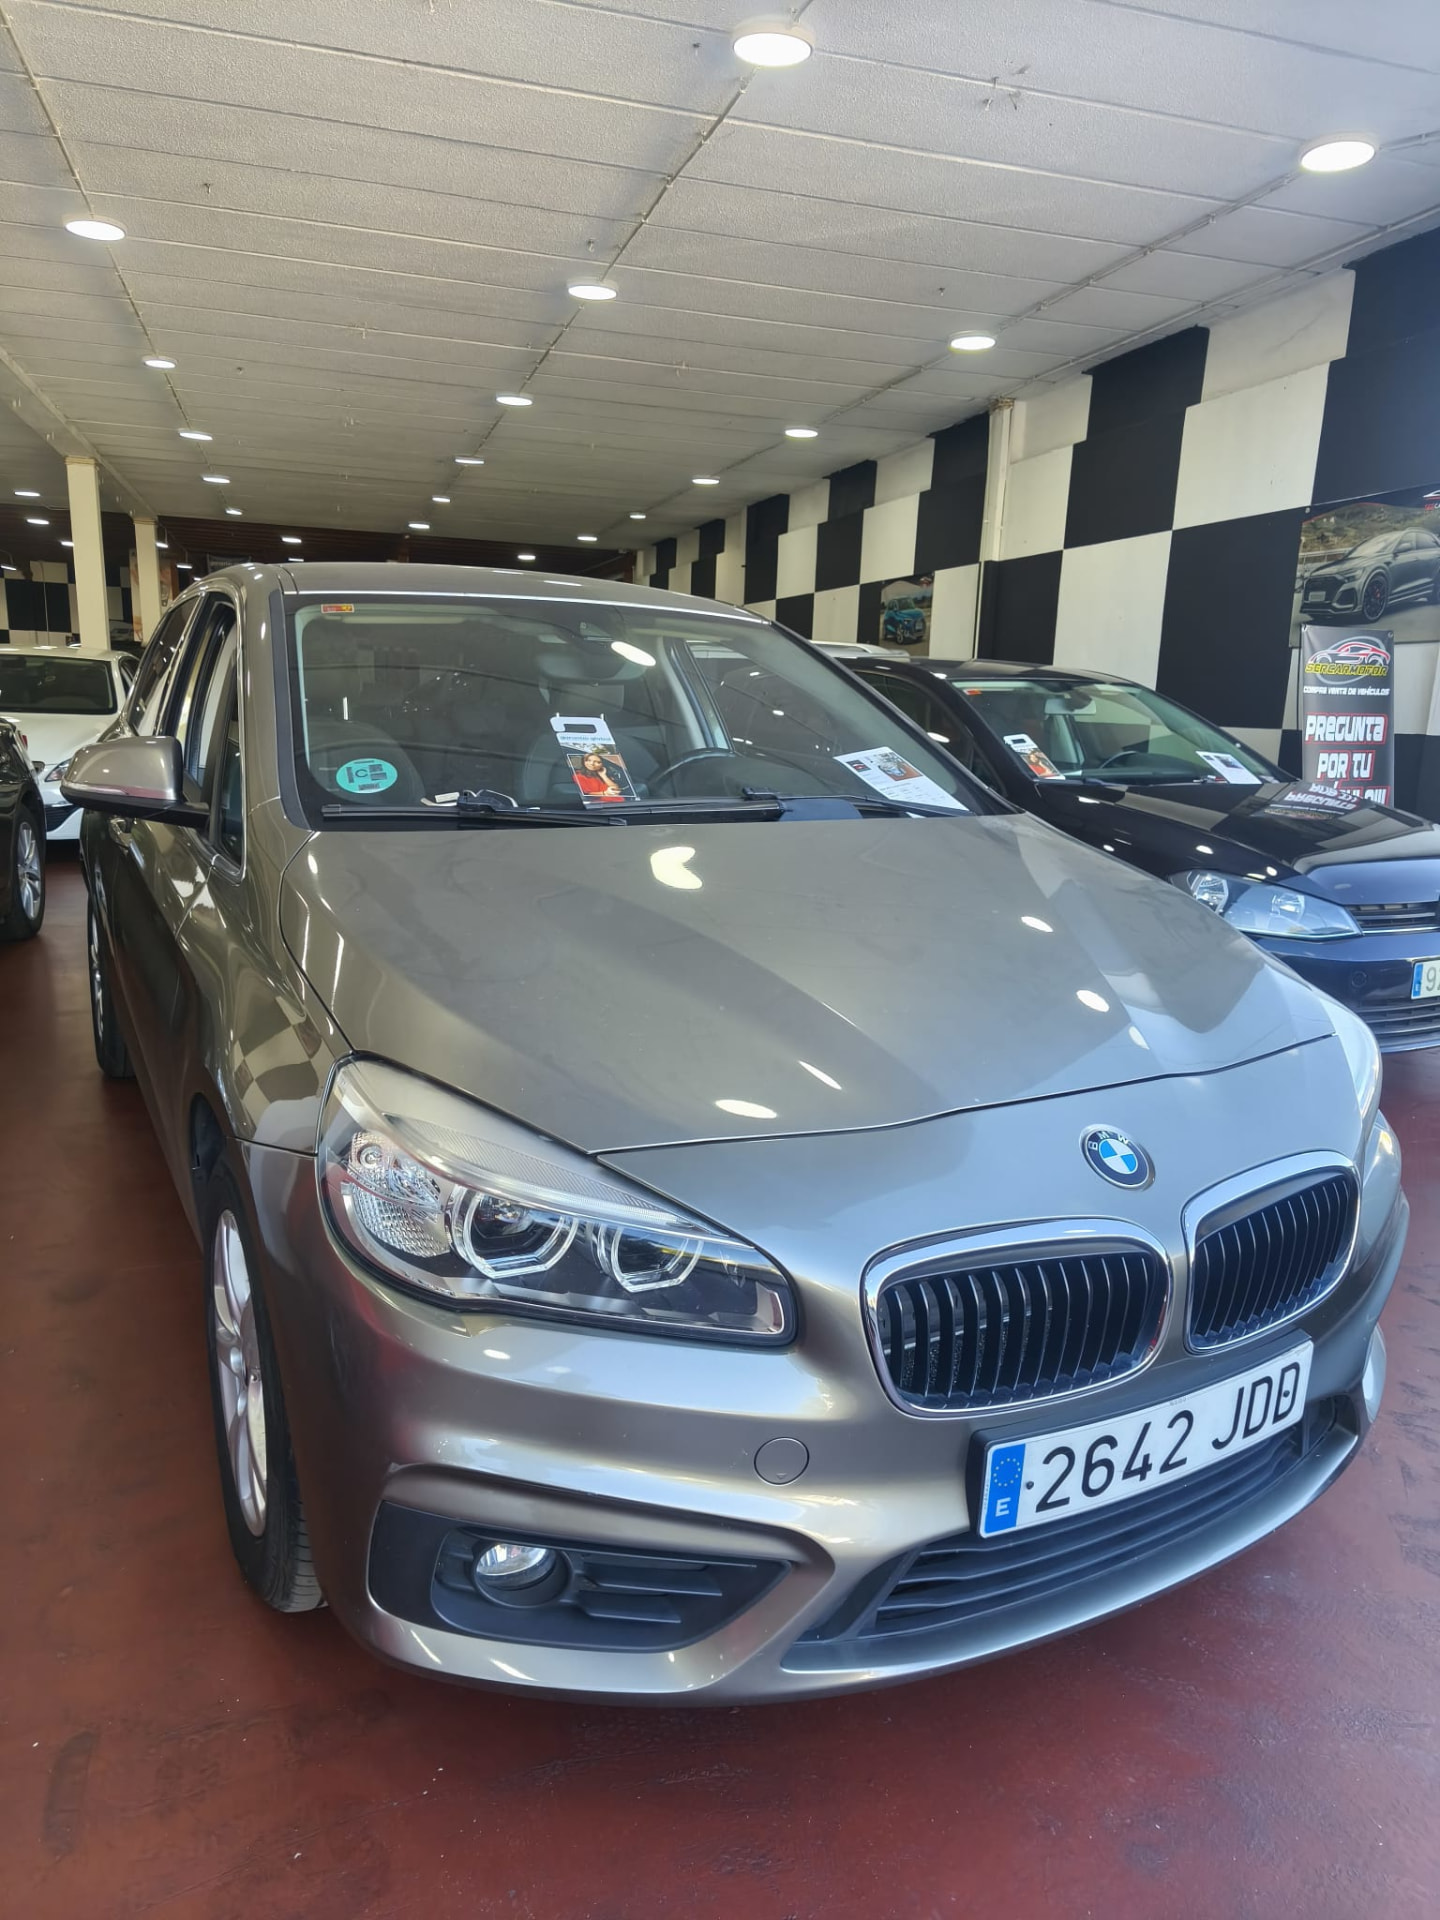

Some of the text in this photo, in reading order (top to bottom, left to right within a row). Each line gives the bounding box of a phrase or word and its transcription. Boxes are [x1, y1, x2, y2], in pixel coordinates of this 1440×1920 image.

[1305, 714, 1385, 742] PREGUNTA
[1316, 752, 1373, 779] POR TU
[1426, 966, 1440, 992] 9
[1088, 1131, 1129, 1151] BMW
[1035, 1362, 1300, 1513] 2642 JDD
[995, 1497, 1011, 1518] E
